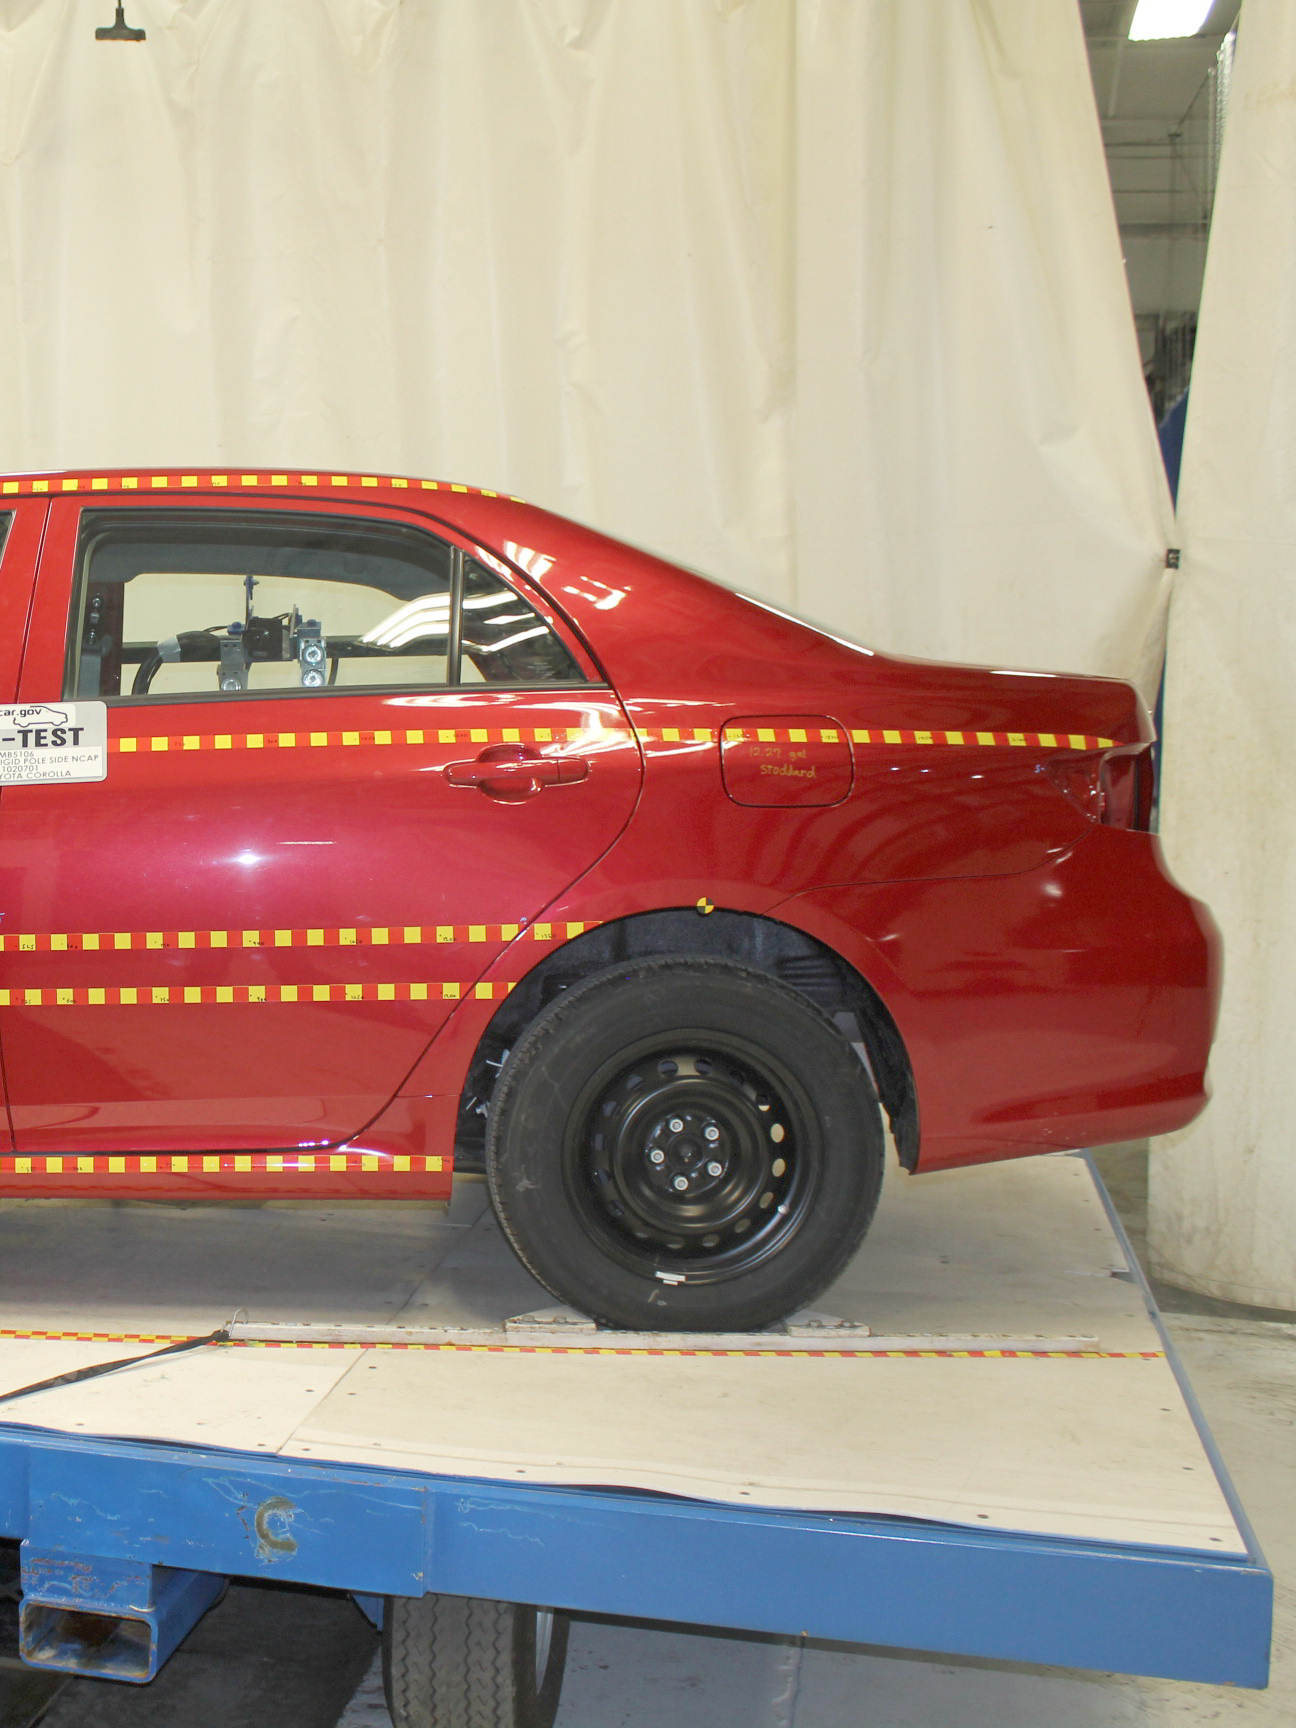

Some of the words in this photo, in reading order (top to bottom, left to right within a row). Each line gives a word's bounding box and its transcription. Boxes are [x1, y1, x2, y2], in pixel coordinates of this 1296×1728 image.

[23, 757, 46, 765] POLE
[49, 756, 69, 764] SIDE
[71, 755, 99, 763] NCAP
[26, 770, 71, 779] COROLLA
